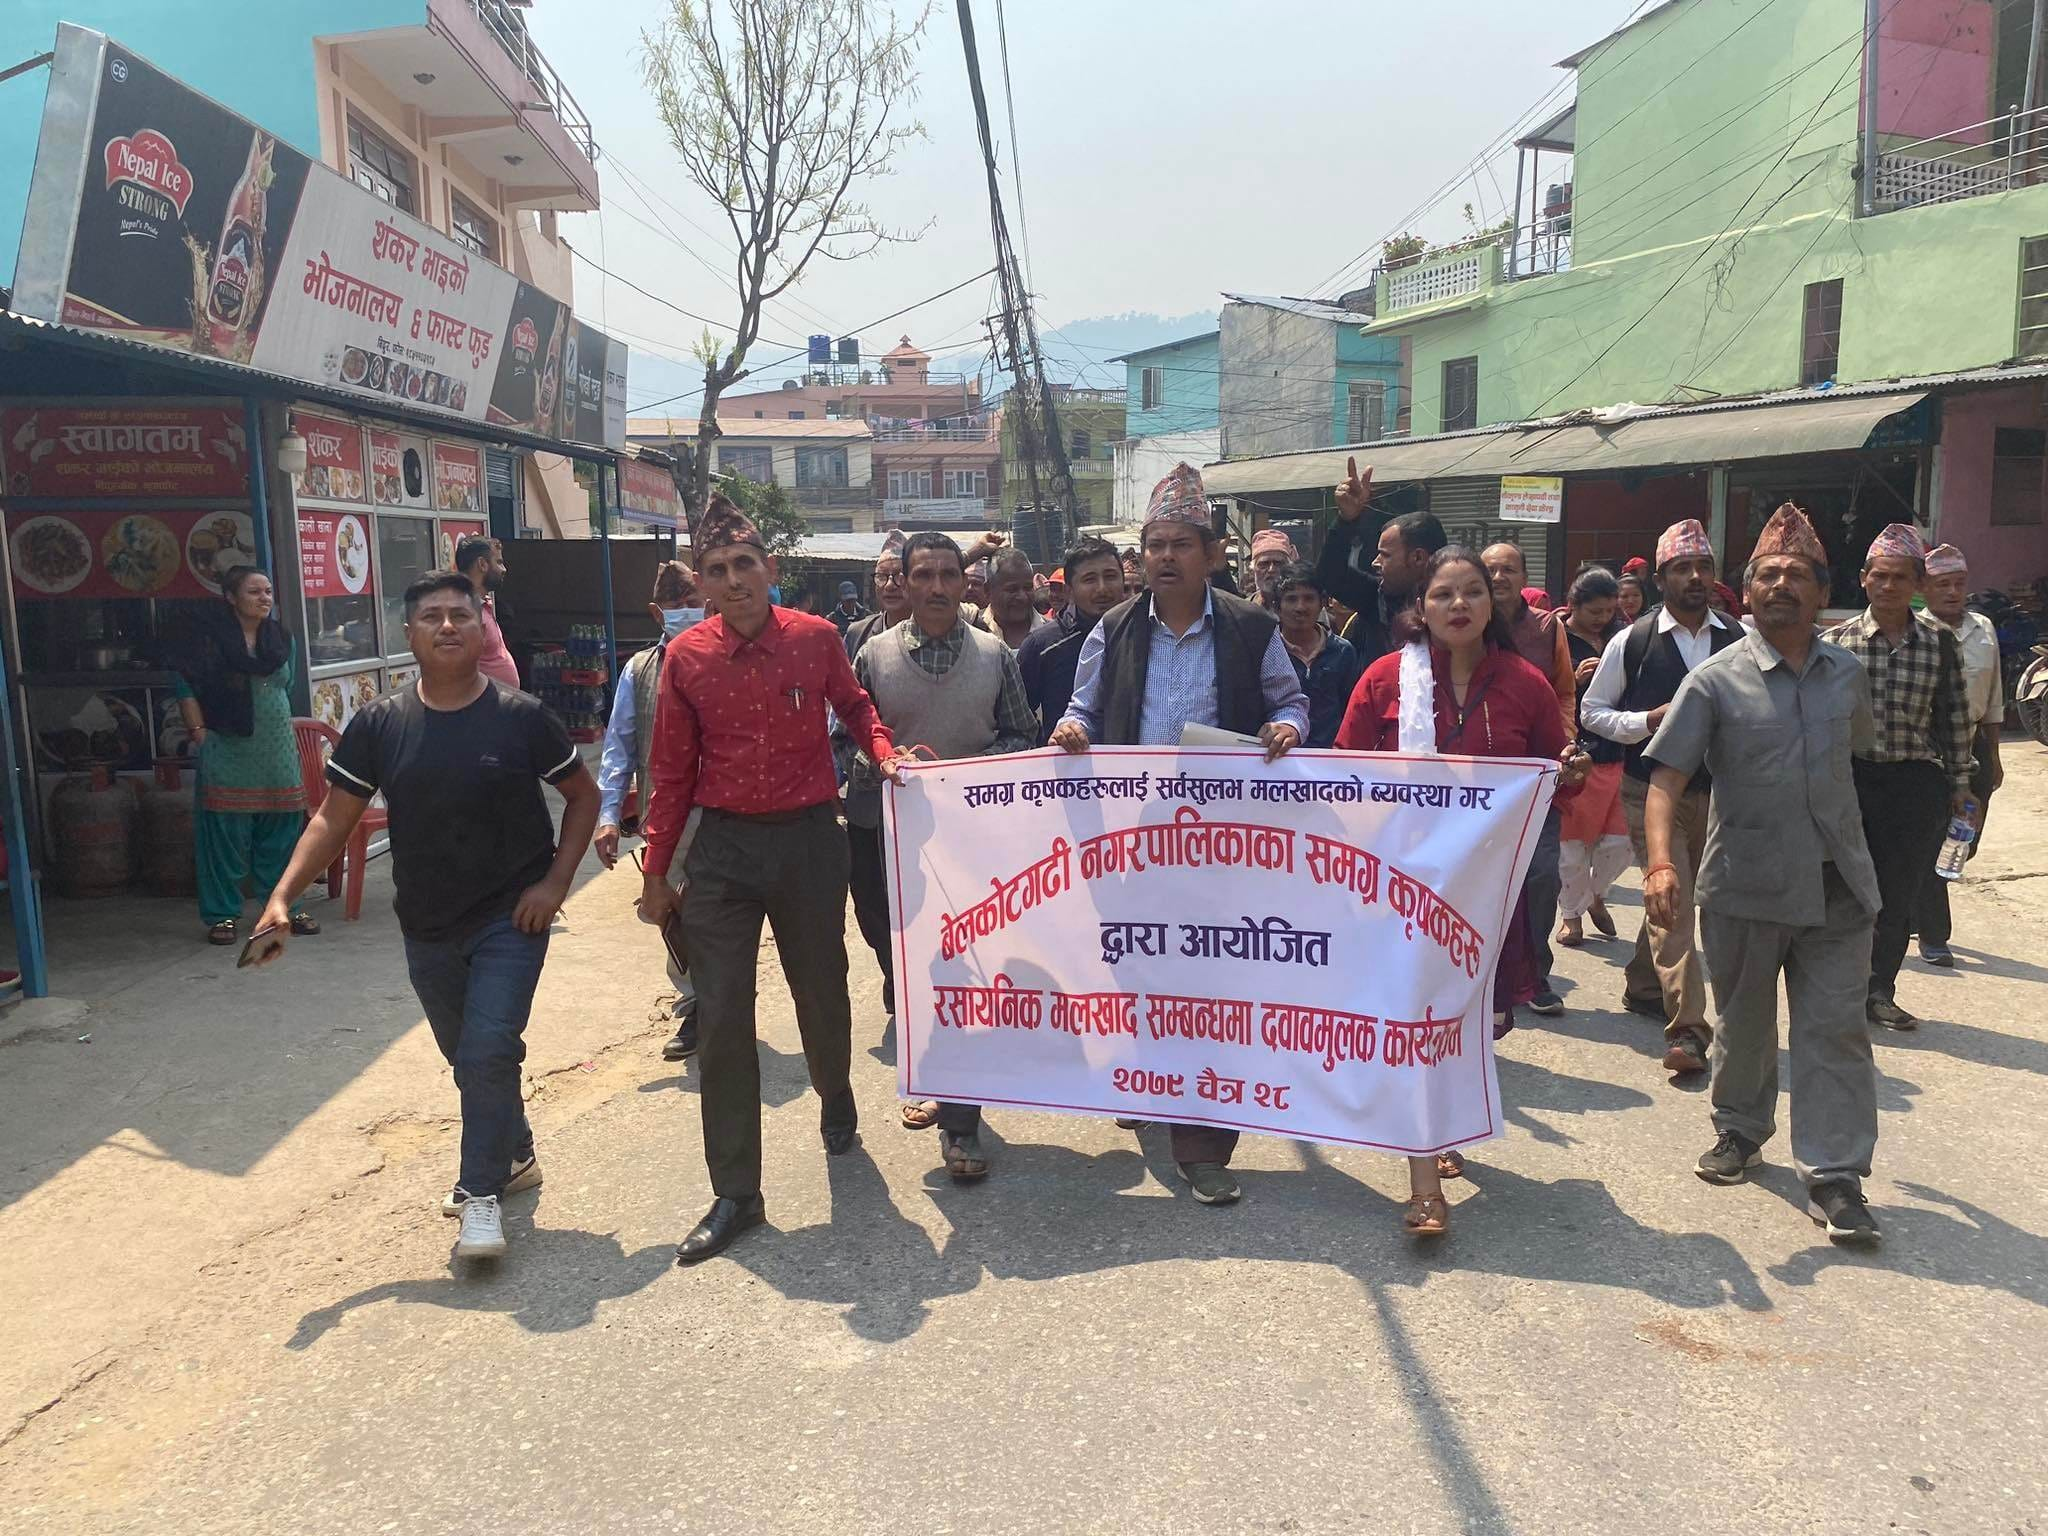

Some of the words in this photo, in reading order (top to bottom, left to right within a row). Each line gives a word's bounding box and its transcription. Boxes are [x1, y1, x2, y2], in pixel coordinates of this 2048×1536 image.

[118, 144, 158, 181] Nepal
[161, 163, 182, 192] Ice
[119, 185, 168, 221] STRONG
[372, 216, 420, 272] शंकर
[422, 247, 469, 295] भाइको
[303, 250, 404, 328] भोजनालय
[427, 310, 467, 349] फास्ट
[469, 326, 493, 369] फुड
[59, 425, 205, 458] स्वागतम्
[308, 428, 342, 462] शंकर
[964, 782, 1014, 808] समग्र
[1156, 772, 1244, 805] सर्वसुलभ
[1250, 774, 1364, 804] मलखादको
[1371, 782, 1453, 808] ब्यवस्था
[1460, 786, 1495, 811] गर
[940, 836, 1072, 962] बेलकोटगढी
[1079, 806, 1296, 880] नगरपालिकाका
[1305, 833, 1381, 905] समग्र
[1100, 922, 1168, 964] द्वारा
[1179, 916, 1332, 967] आयोजित
[933, 973, 1043, 1030] रसायनिक
[1050, 990, 1138, 1039] मलखाद
[1145, 994, 1254, 1046] सम्बन्धमा
[1260, 1002, 1378, 1072] दवावमुलक
[1112, 1067, 1184, 1098] २०७९
[1196, 1066, 1246, 1104] चैत्र
[1254, 1082, 1290, 1110] २८
